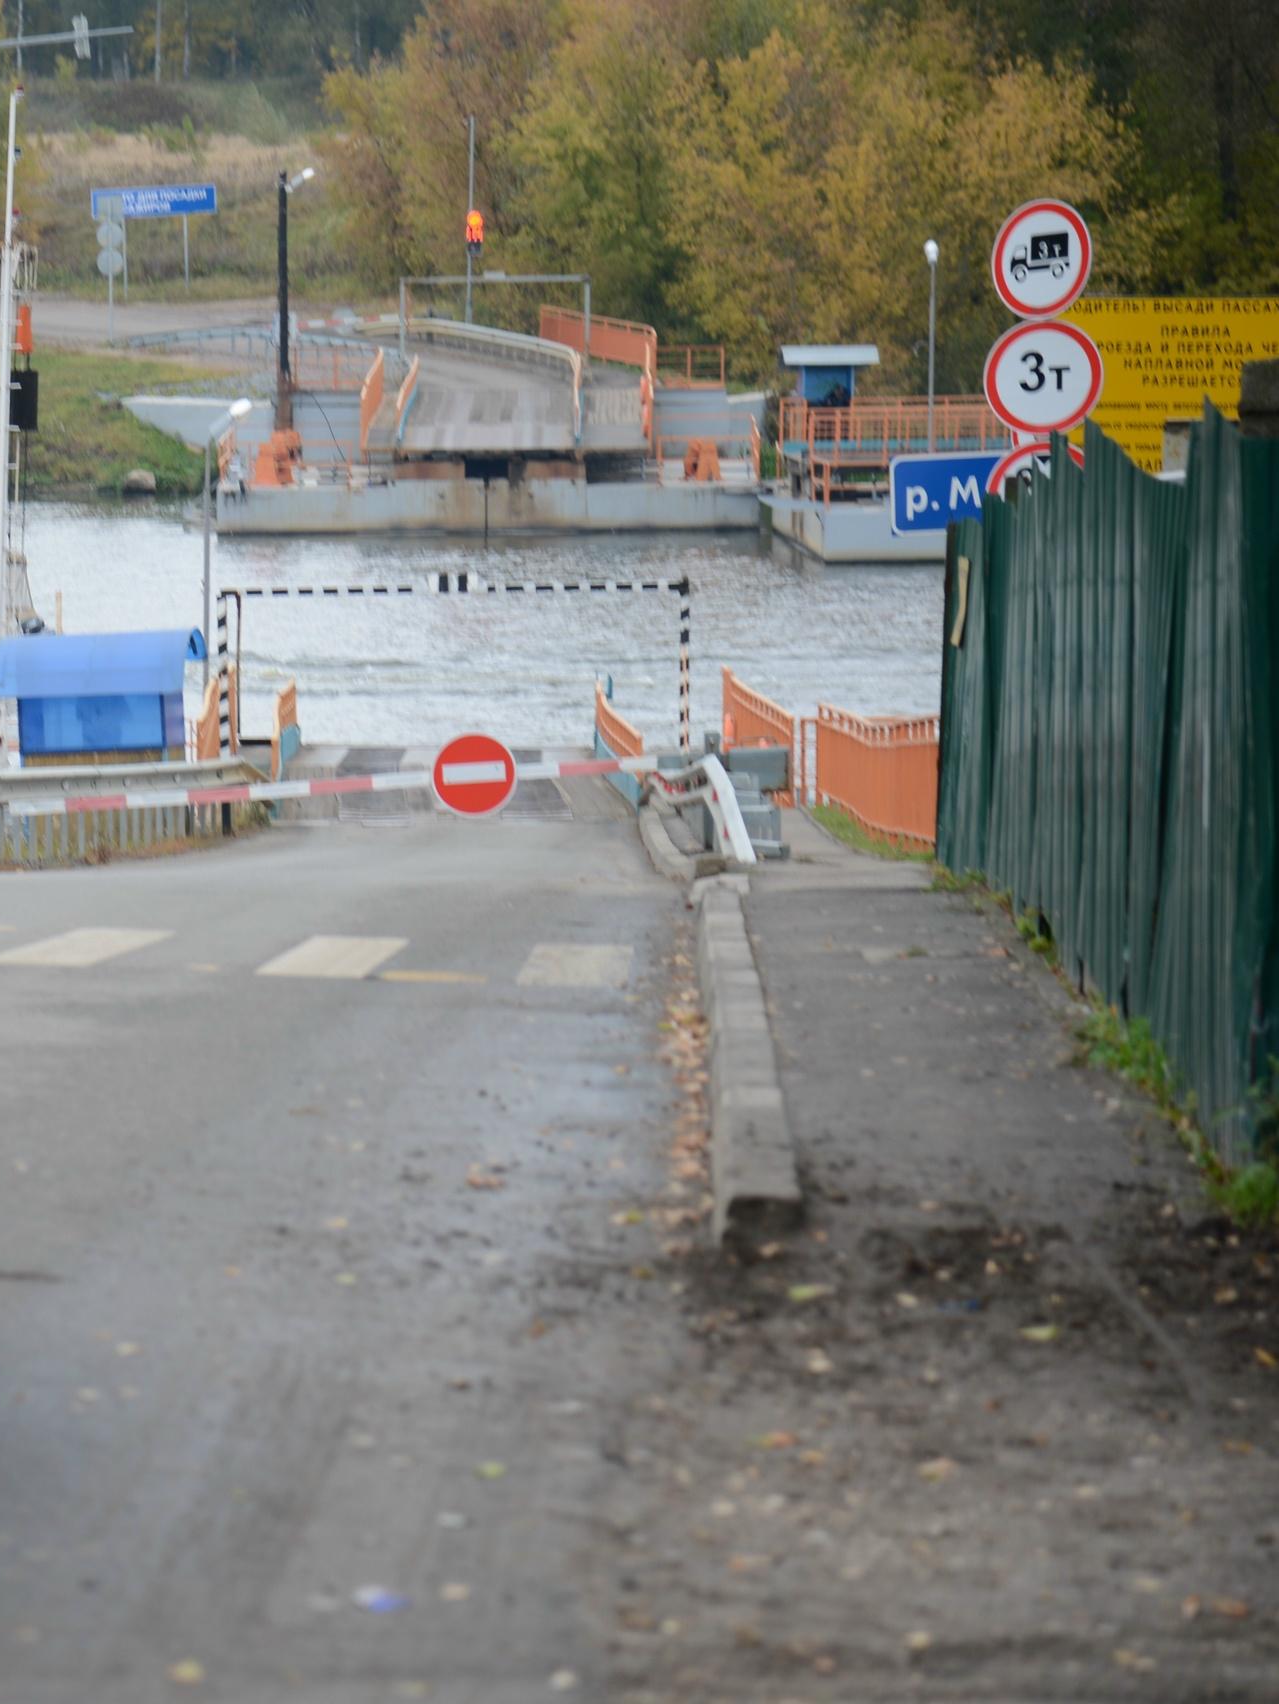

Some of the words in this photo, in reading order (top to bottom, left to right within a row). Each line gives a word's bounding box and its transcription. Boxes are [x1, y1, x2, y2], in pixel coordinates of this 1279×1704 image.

[1067, 300, 1147, 314] ОДИТЕЛЬ!
[1153, 300, 1215, 314] ВЫСАДИ
[1160, 325, 1231, 338] ПРАВИЛА
[1096, 341, 1152, 354] РОЕЗДА
[1160, 341, 1170, 353] И
[1177, 341, 1254, 354] ПЕРЕХОДА
[1261, 341, 1279, 354] ЧЕ
[1123, 357, 1214, 370] НАПЛАВНОЙ
[1222, 357, 1244, 370] МО
[1142, 374, 1241, 387] РАЗРЕШАЕТС
[906, 484, 940, 521] р.
[949, 475, 983, 510] М
